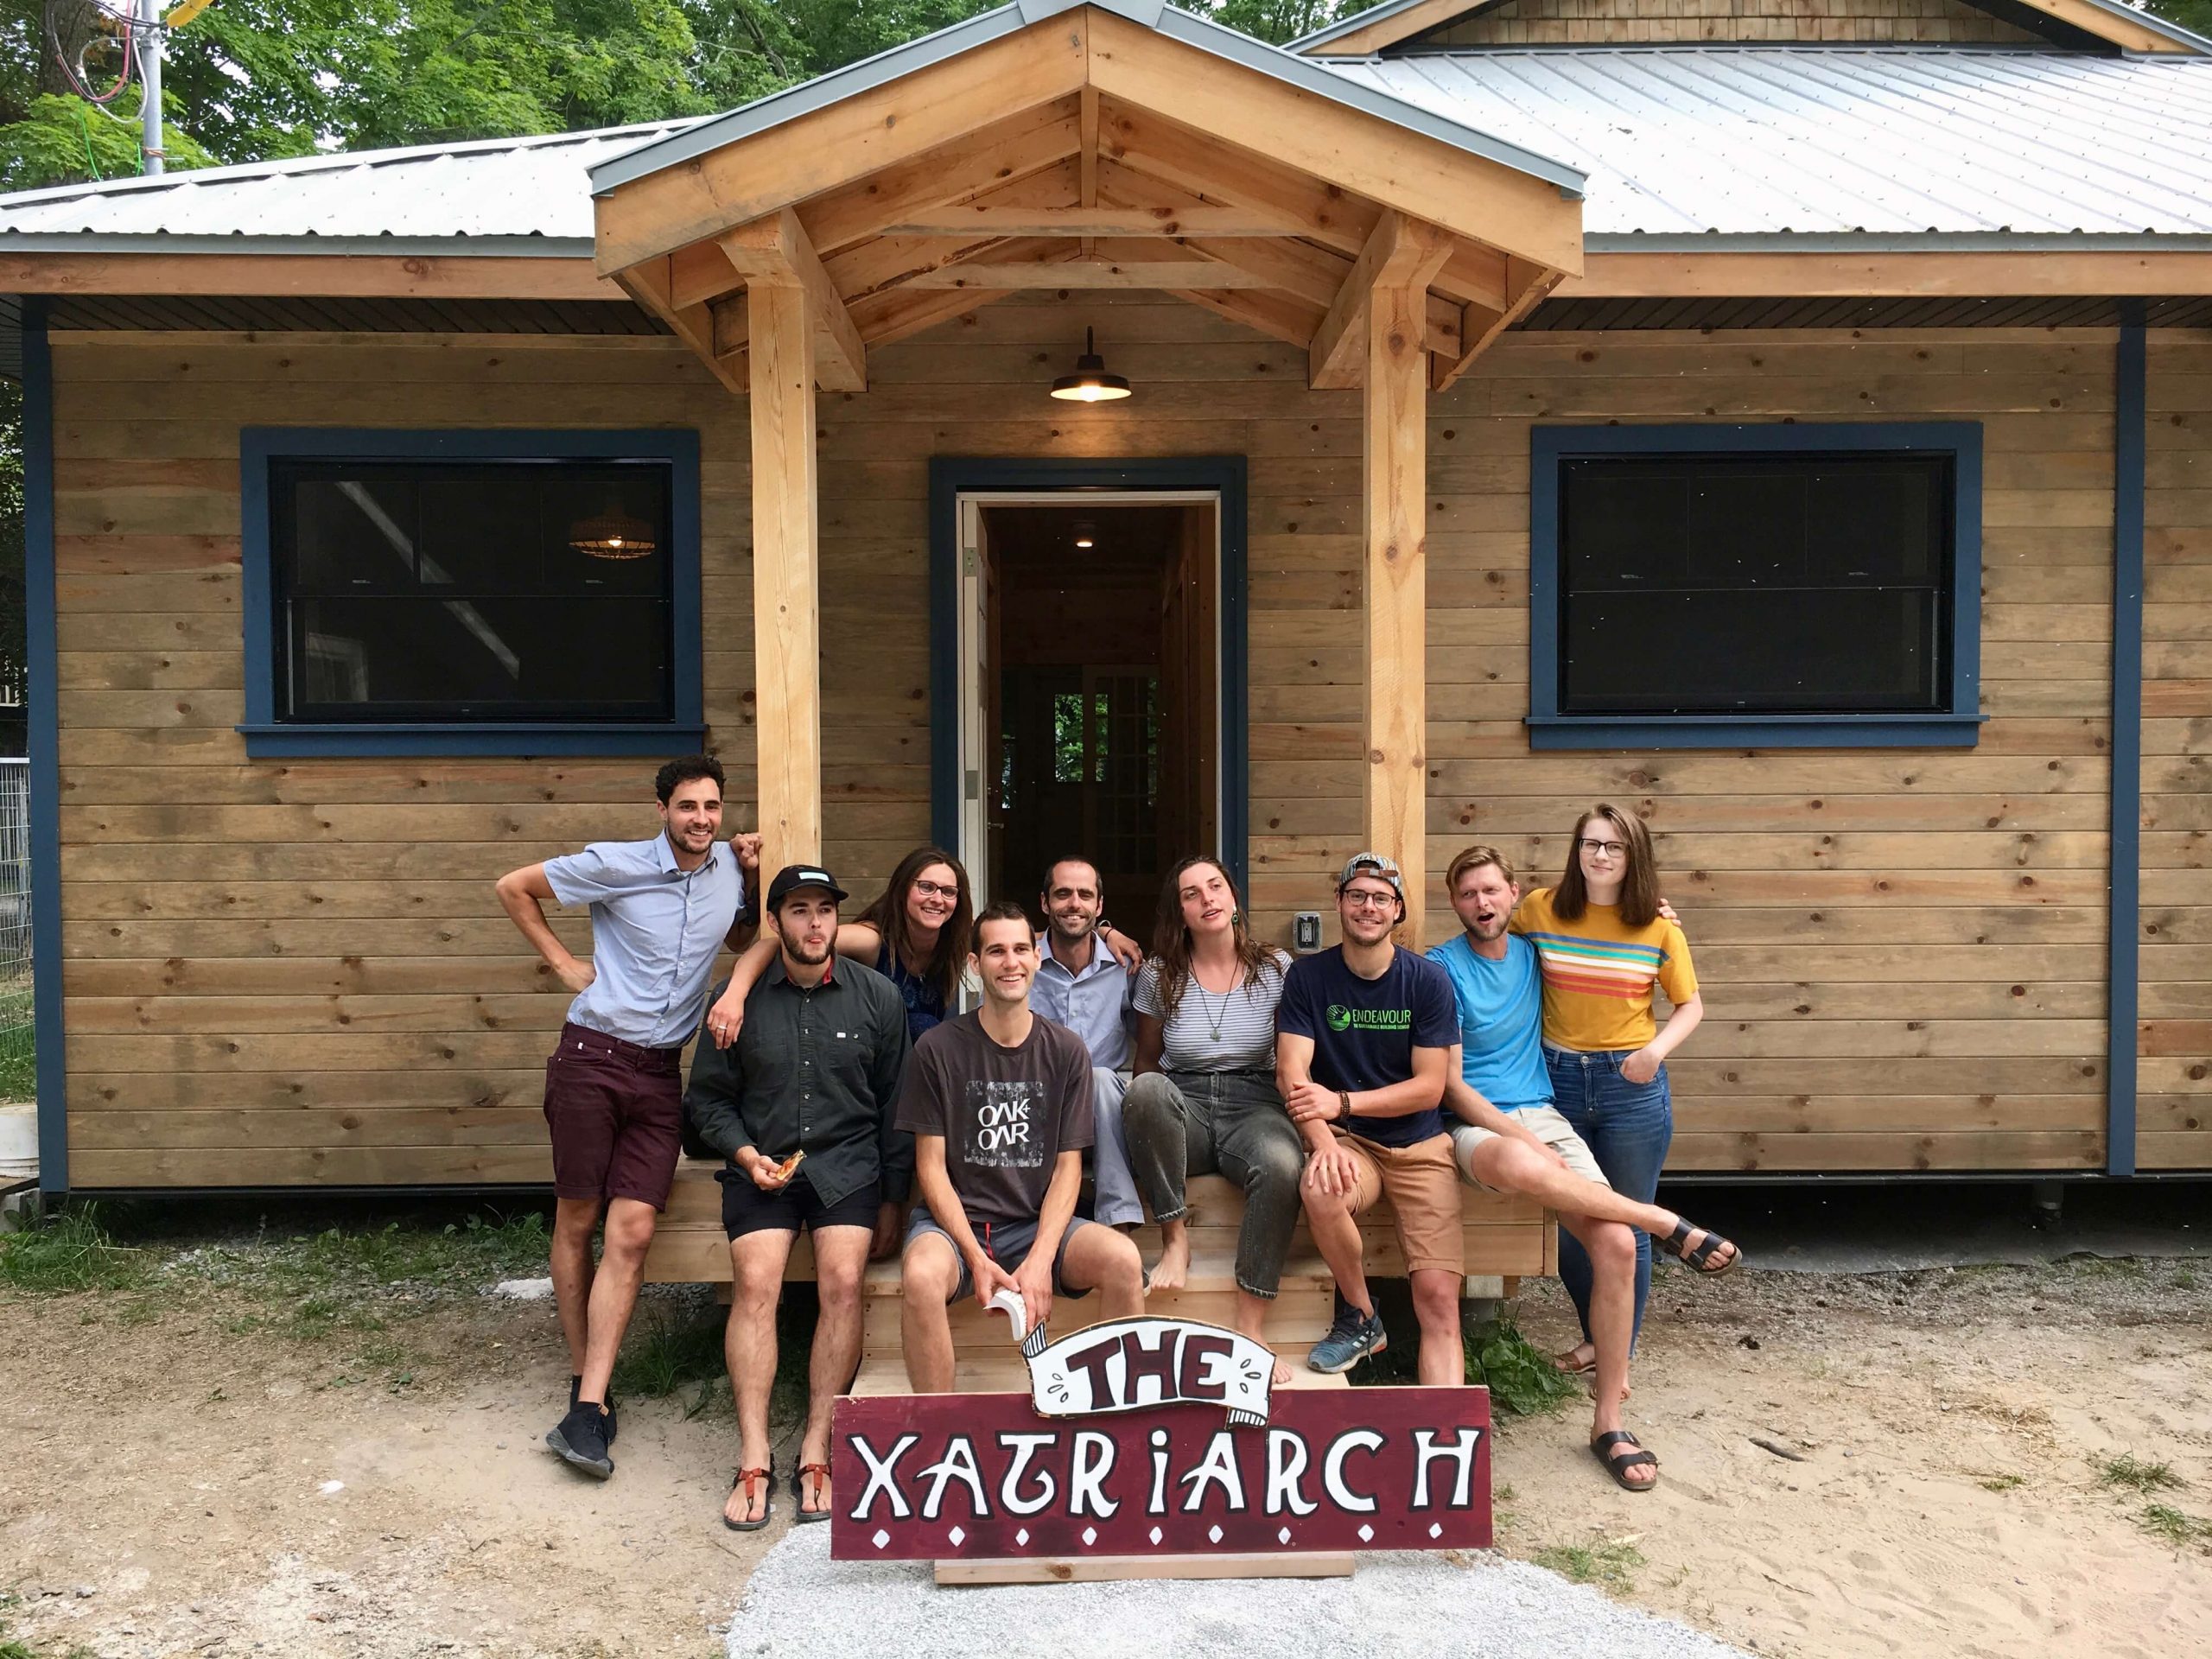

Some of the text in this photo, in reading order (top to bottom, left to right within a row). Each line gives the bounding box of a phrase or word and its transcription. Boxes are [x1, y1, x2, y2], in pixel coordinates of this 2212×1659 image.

[1352, 1009, 1411, 1023] ENDEAVOUR
[977, 1122, 1030, 1150] OAR
[1065, 1328, 1234, 1410] THE
